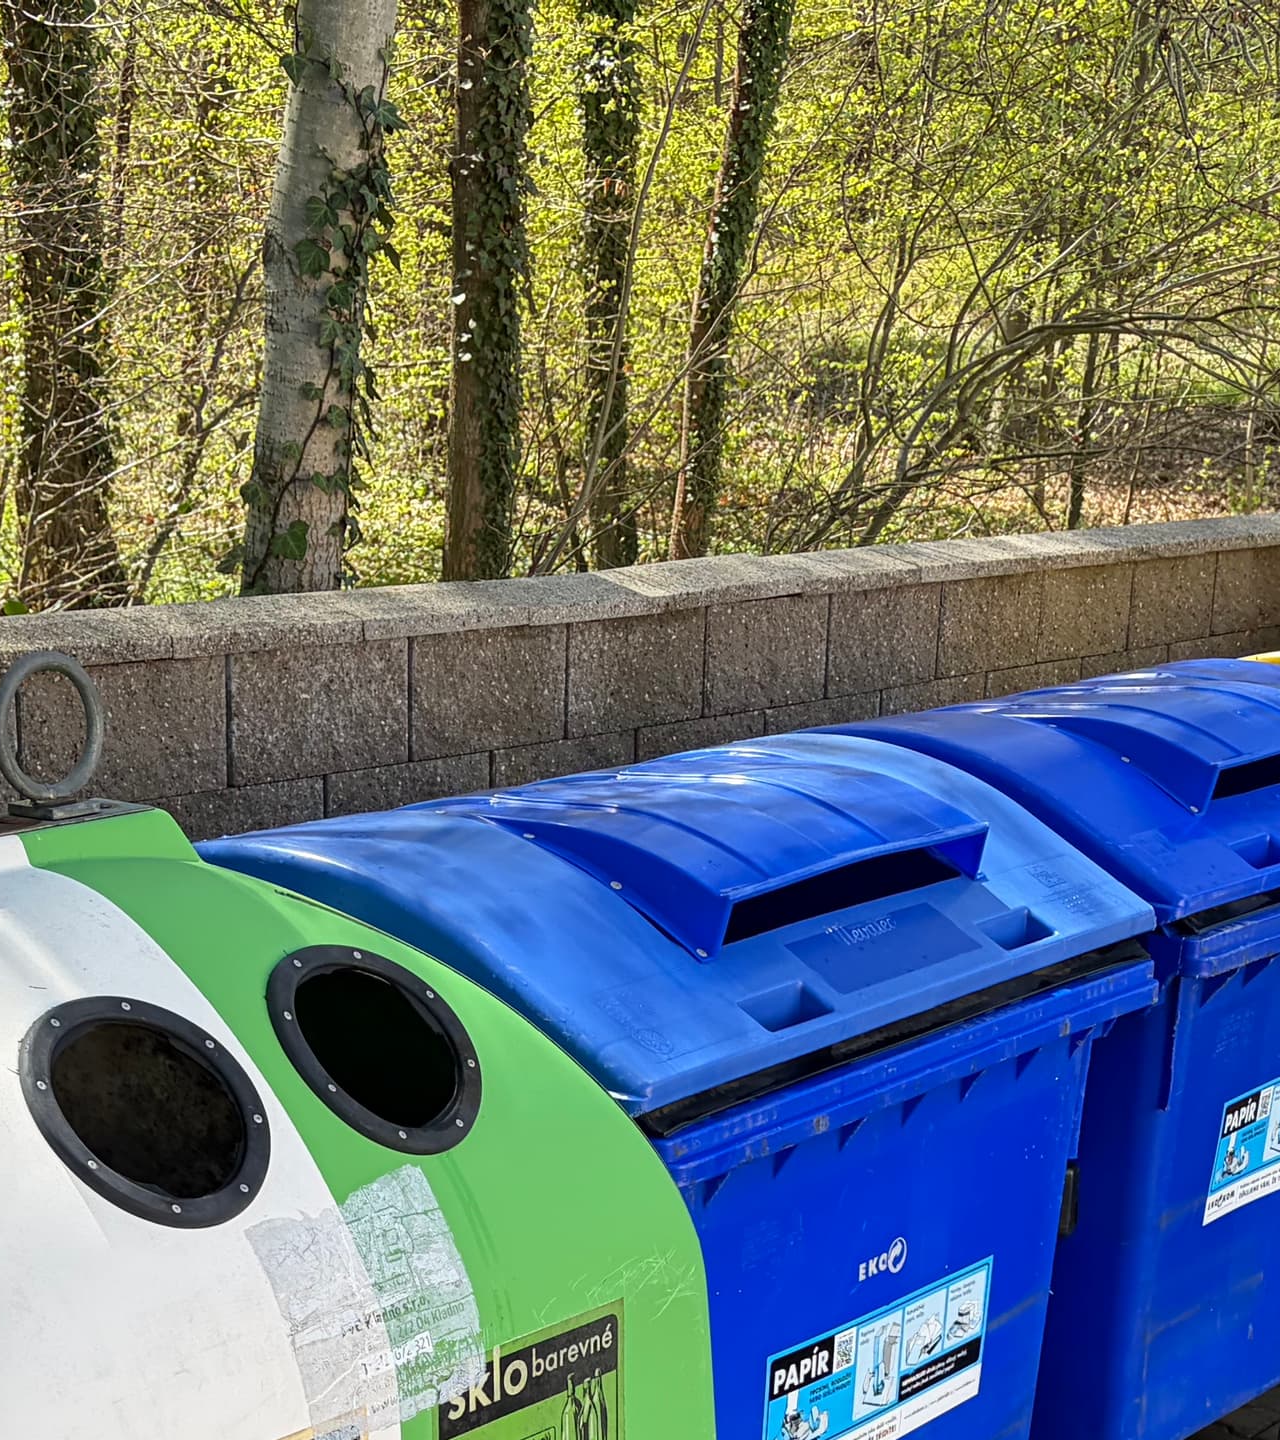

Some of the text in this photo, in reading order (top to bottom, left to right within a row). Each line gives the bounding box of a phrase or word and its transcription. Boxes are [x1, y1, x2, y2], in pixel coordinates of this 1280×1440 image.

[1224, 1098, 1256, 1134] PAPÍR
[432, 1301, 464, 1321] Kladno
[448, 1346, 528, 1420] sklo
[532, 1323, 613, 1378] barevné
[774, 1346, 829, 1395] PAPÍR
